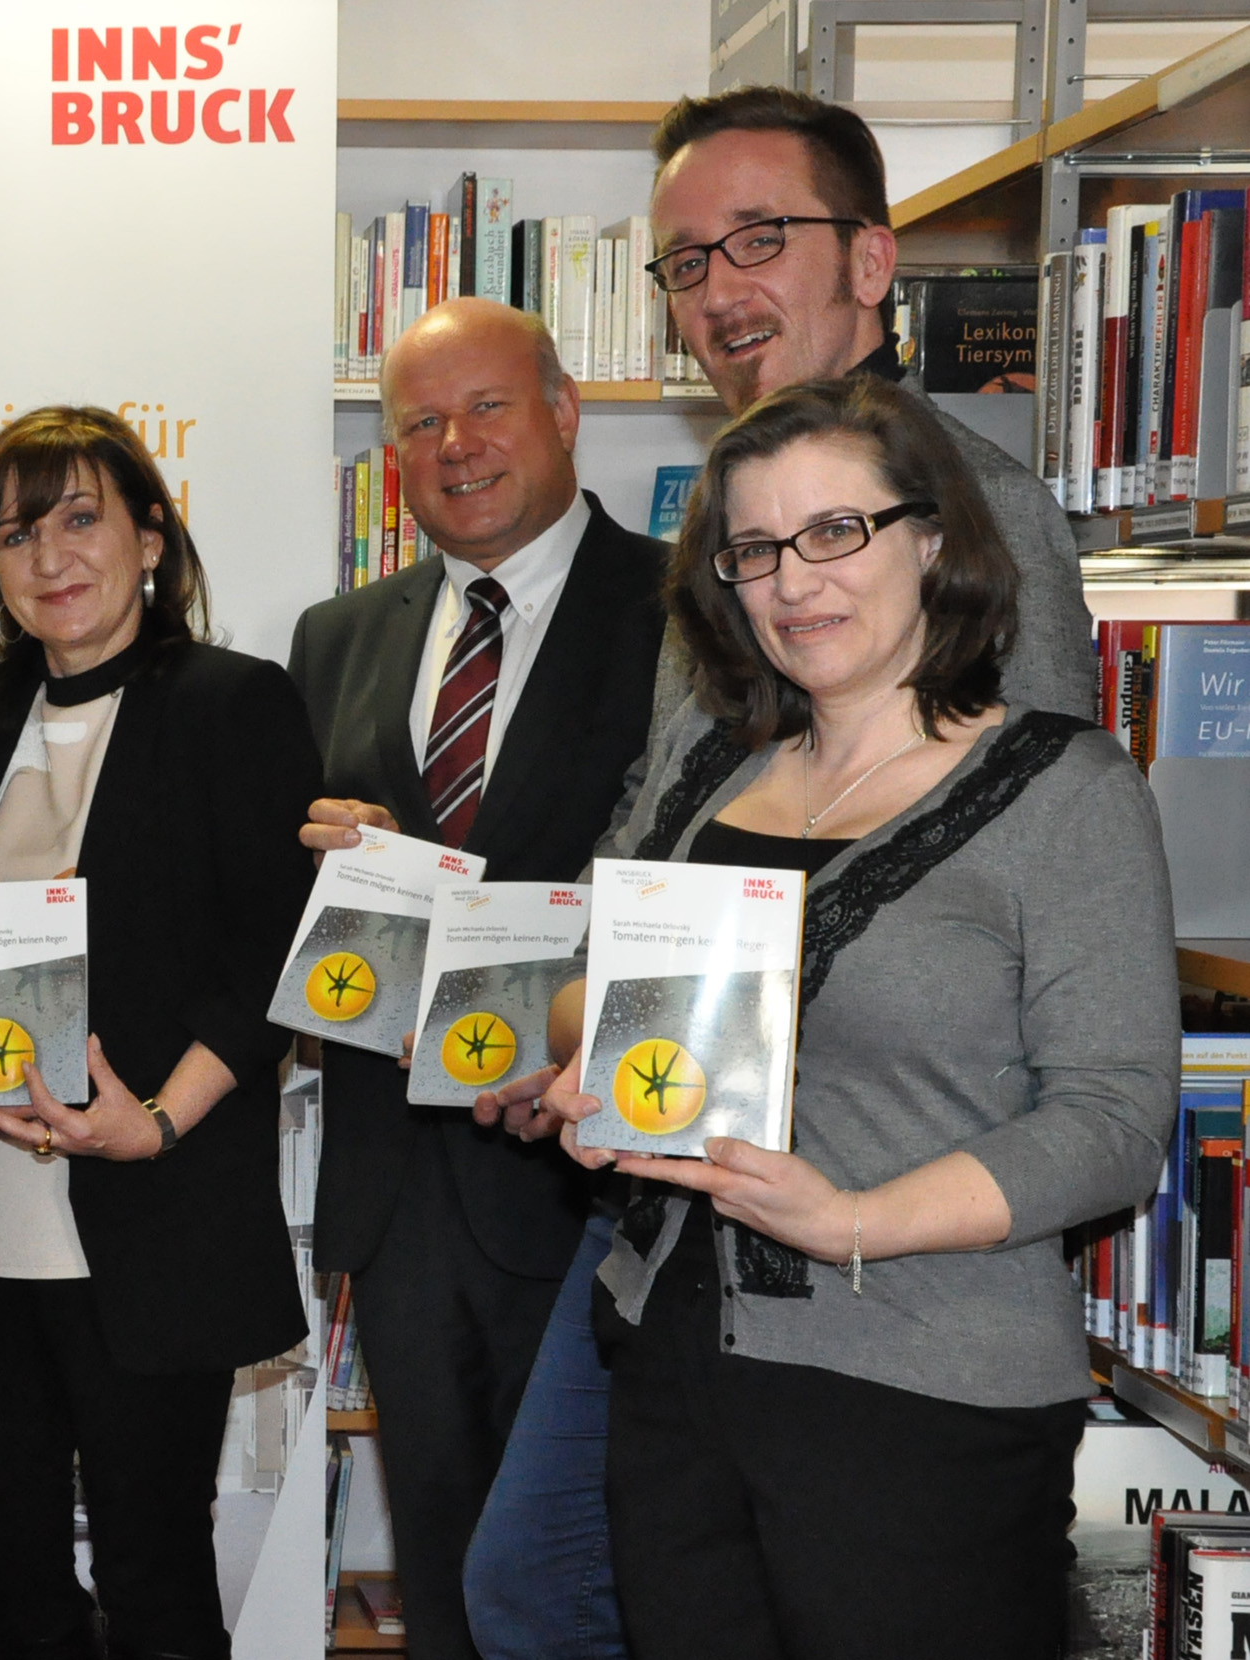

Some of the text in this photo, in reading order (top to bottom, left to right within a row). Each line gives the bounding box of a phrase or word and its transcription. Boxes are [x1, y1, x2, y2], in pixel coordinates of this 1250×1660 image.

[52, 23, 242, 82] INNS'
[52, 88, 296, 145] BRUCK
[484, 229, 495, 295] Kursbuch
[495, 229, 506, 295] Gesundheit
[963, 321, 1036, 340] Lexikon
[956, 344, 1032, 368] Tiersym
[1046, 270, 1062, 434] DER ZUG DER LEMMINGE
[1152, 295, 1165, 412] CHARAKTERFEHLER
[344, 471, 353, 537] Anti-Hormon-Buch
[386, 506, 397, 529] 100
[344, 539, 352, 553] Das
[386, 531, 395, 546] bis
[1119, 651, 1134, 729] campus
[1201, 672, 1245, 696] Wir
[1130, 665, 1142, 763] TILLE PUTSCH
[1198, 720, 1250, 740] EU-
[438, 861, 470, 876] BRUCK
[336, 871, 423, 901] Tomaten mögen keinen
[743, 888, 784, 900] BRUCK
[46, 895, 75, 904] BRUCK
[549, 897, 583, 907] BRUCK
[633, 921, 661, 930] Michaela
[19, 936, 43, 945] keinen
[45, 935, 68, 945] Regen
[445, 934, 569, 945] Tomaten mögen keinen Regen
[612, 930, 657, 944] Tomaten
[659, 934, 695, 948] mögen
[1182, 1571, 1204, 1660] TASEN
